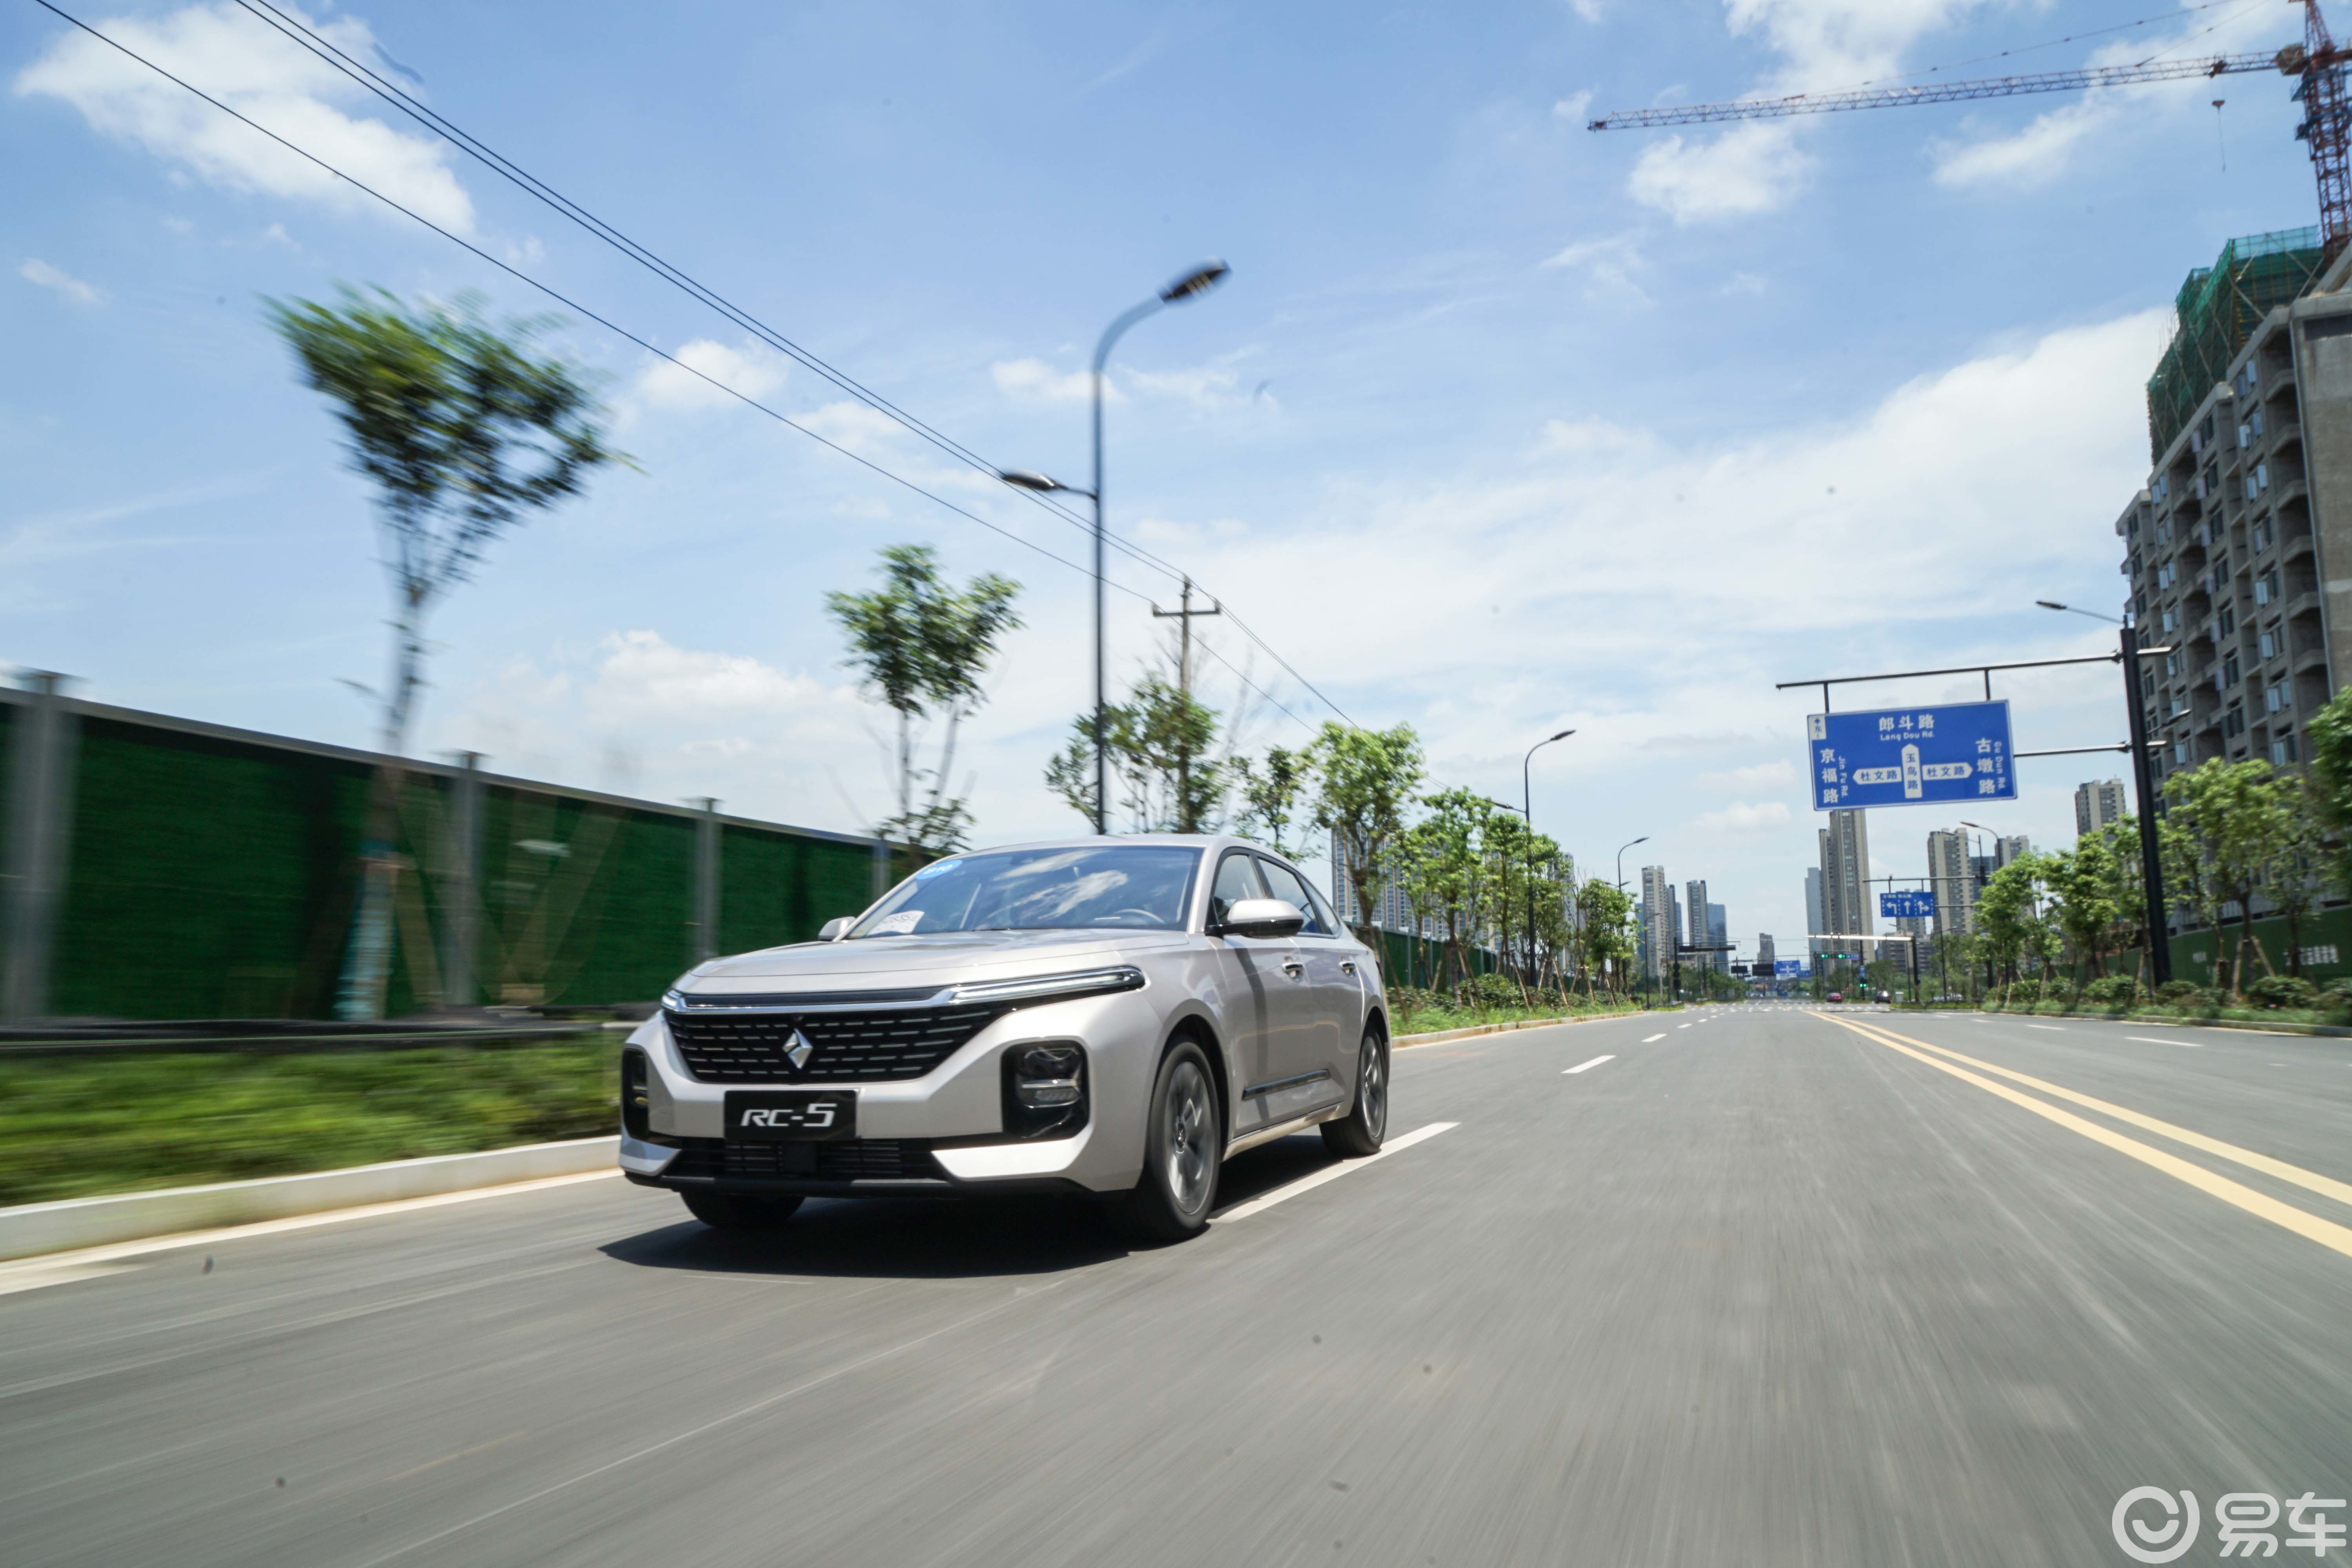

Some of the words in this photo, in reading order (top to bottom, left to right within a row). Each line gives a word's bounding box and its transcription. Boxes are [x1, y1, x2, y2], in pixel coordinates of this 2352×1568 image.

[1879, 714, 1935, 731] 郎斗路
[1820, 748, 1838, 803] 京福路
[1860, 770, 1897, 781] 杜文路
[1927, 766, 1965, 777] 杜文路
[1975, 737, 1995, 794] 古墩路
[740, 1103, 837, 1127] RC-5
